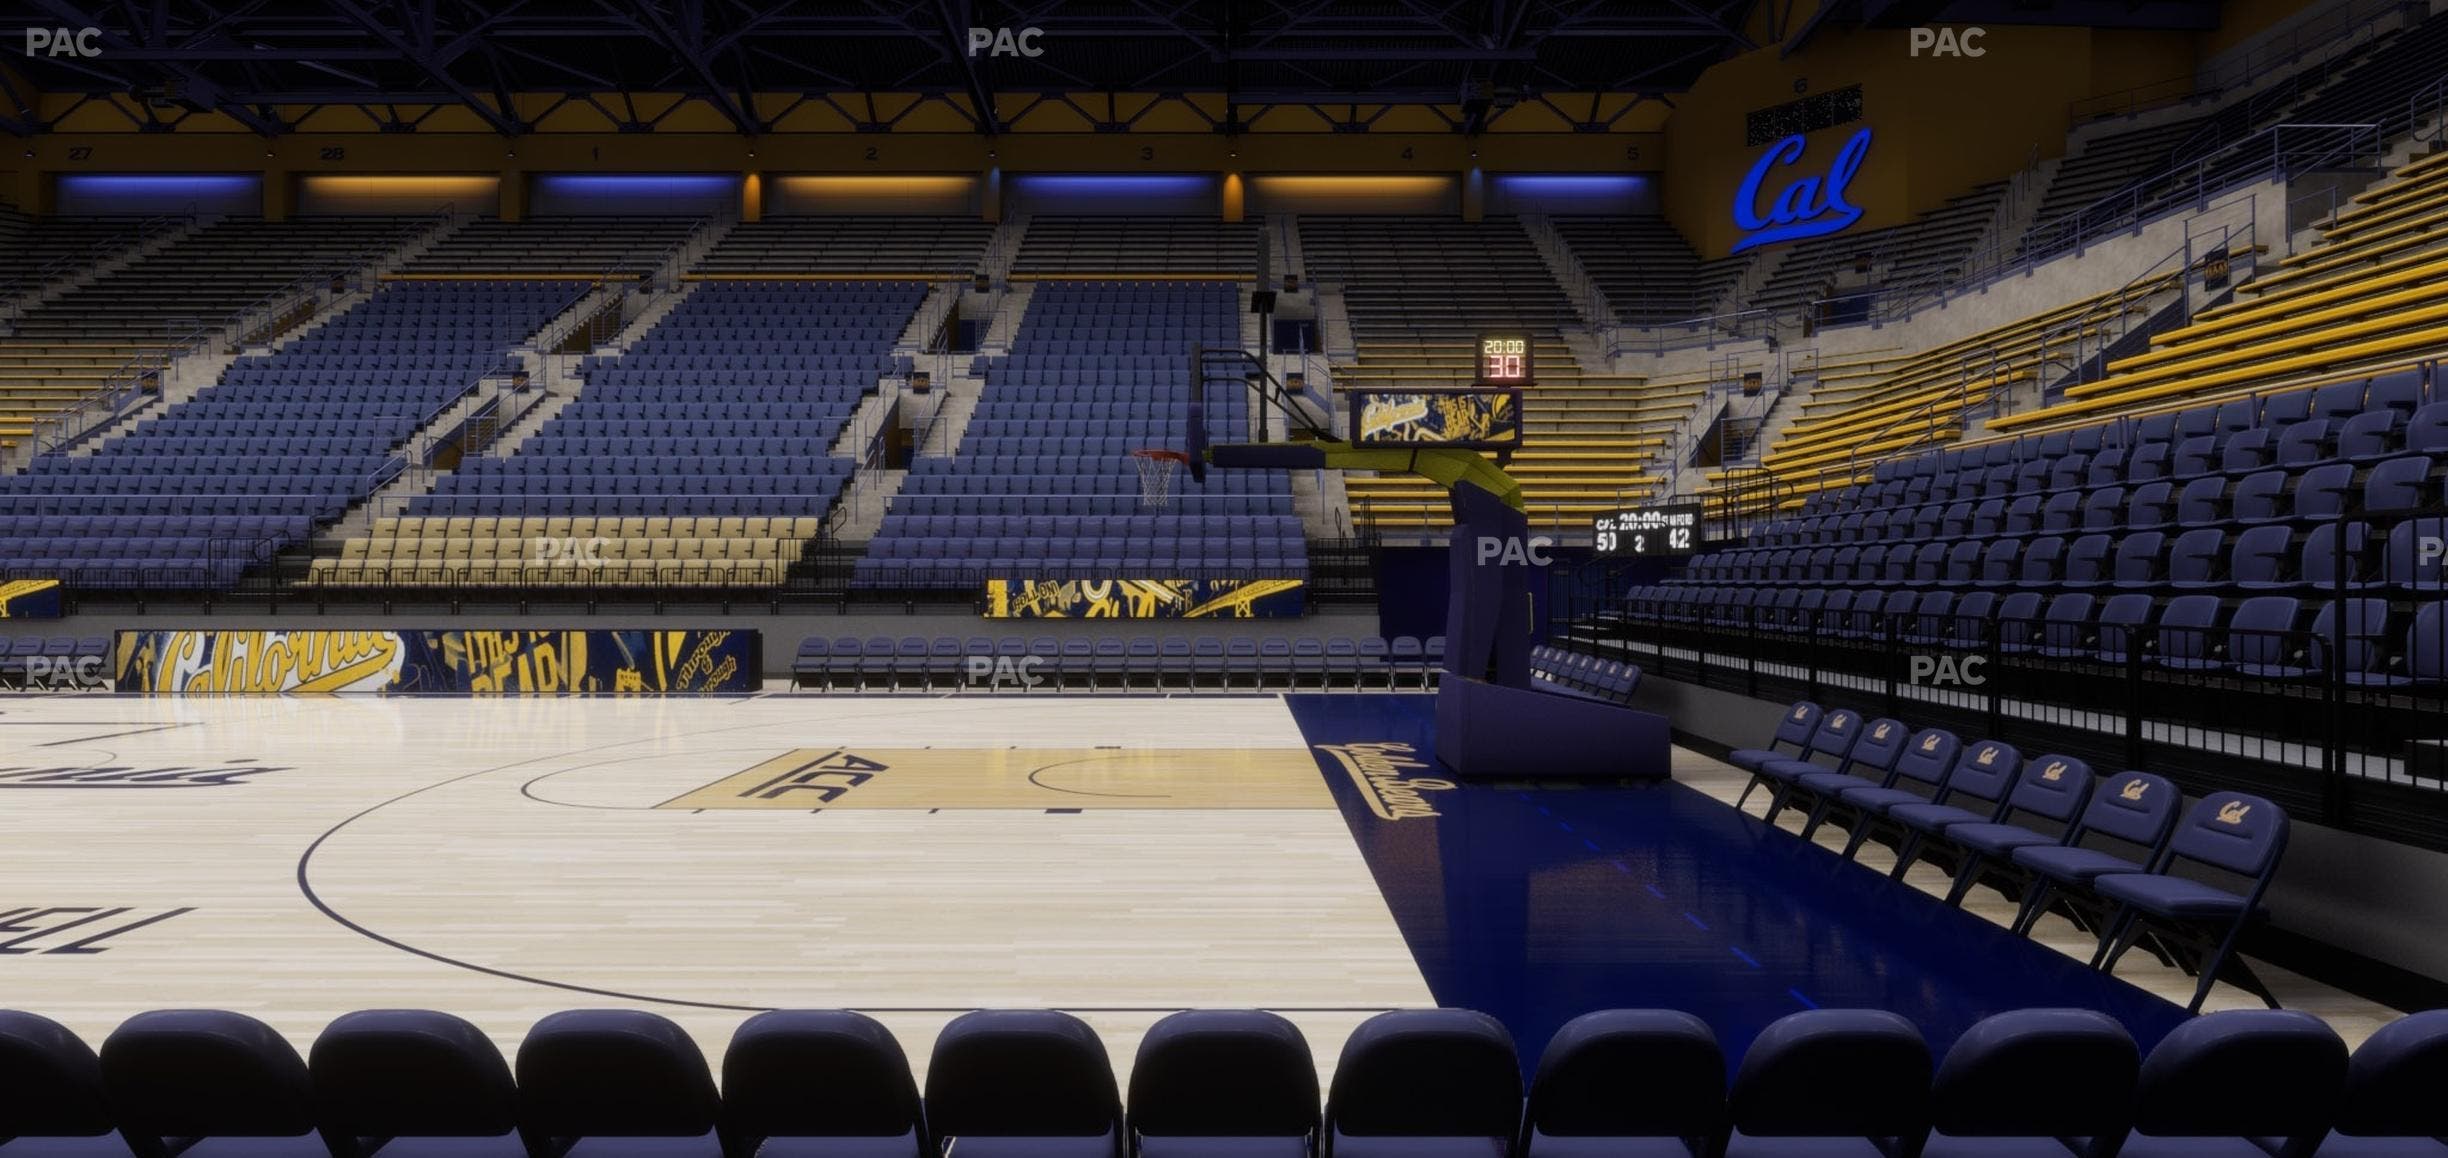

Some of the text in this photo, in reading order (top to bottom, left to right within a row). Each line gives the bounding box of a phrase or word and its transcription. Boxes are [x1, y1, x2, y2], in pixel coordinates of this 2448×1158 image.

[69, 147, 93, 160] 27
[865, 147, 878, 160] 2
[1141, 147, 1153, 160] 3
[1402, 147, 1413, 160] 4
[1627, 147, 1640, 160] 5
[1731, 126, 1873, 255] Cal
[1484, 340, 1523, 354] 20:00
[1489, 356, 1520, 378] 30
[1619, 511, 1661, 531] 20:00
[1596, 527, 1690, 553] 50 2 42
[757, 754, 890, 803] ACC
